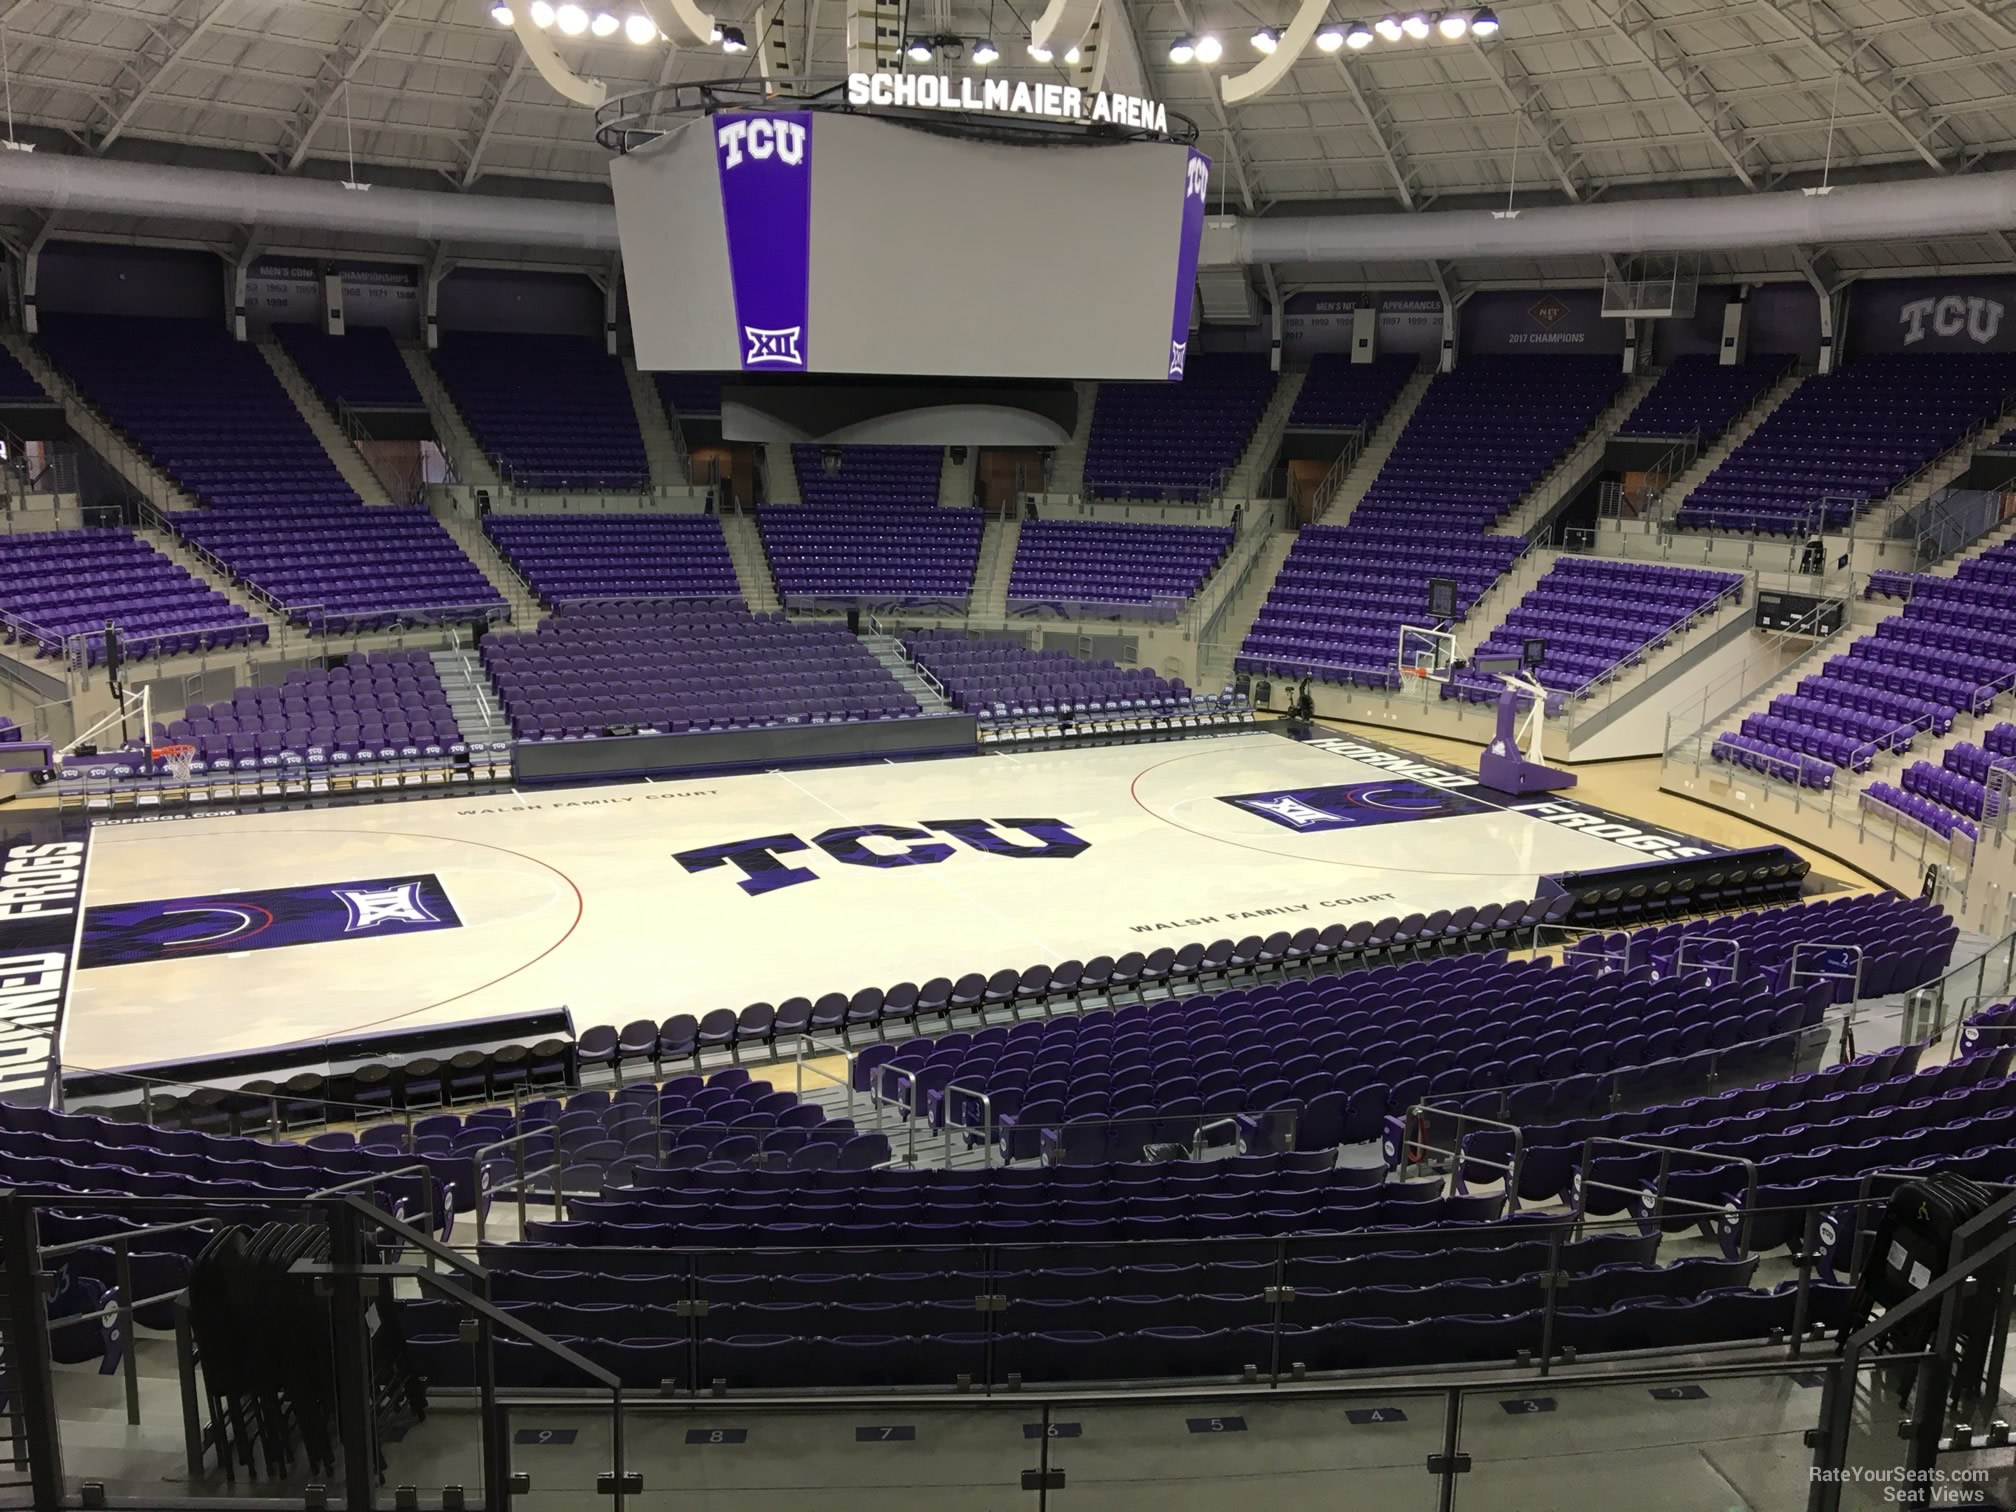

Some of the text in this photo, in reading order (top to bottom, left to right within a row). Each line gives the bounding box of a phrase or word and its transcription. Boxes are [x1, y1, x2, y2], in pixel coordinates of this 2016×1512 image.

[848, 73, 1167, 133] SCHOLLMAIER ARENA
[719, 118, 805, 169] TCU
[1187, 157, 1208, 203] TCU
[1316, 301, 1357, 311] MEN'S NIT
[1382, 301, 1441, 310] APPEARANCES
[1539, 308, 1560, 317] NIT
[1899, 296, 2004, 346] TCU
[1509, 333, 1585, 343] 2017 CHAMPIONS
[358, 751, 372, 759] TCU
[380, 749, 395, 757] TCU
[425, 746, 440, 754] TCU
[1301, 738, 1479, 787] HORNED
[62, 769, 78, 777] TCU
[457, 790, 720, 816] WALSH FAMILY COURT
[92, 810, 236, 827] GOFROGS.COM
[1508, 800, 1713, 860] FROGS
[671, 818, 1093, 897] TCU
[0, 841, 84, 920] FROGS
[1129, 892, 1397, 933] WALSH FAMILY COURT
[1841, 952, 1849, 965] 2
[1525, 1400, 1539, 1413] 3
[1371, 1410, 1384, 1423] 4
[1047, 1423, 1059, 1436] 6
[1212, 1419, 1225, 1432] 5
[538, 1430, 553, 1444] 9
[710, 1430, 724, 1444] 8
[879, 1428, 894, 1441] 7
